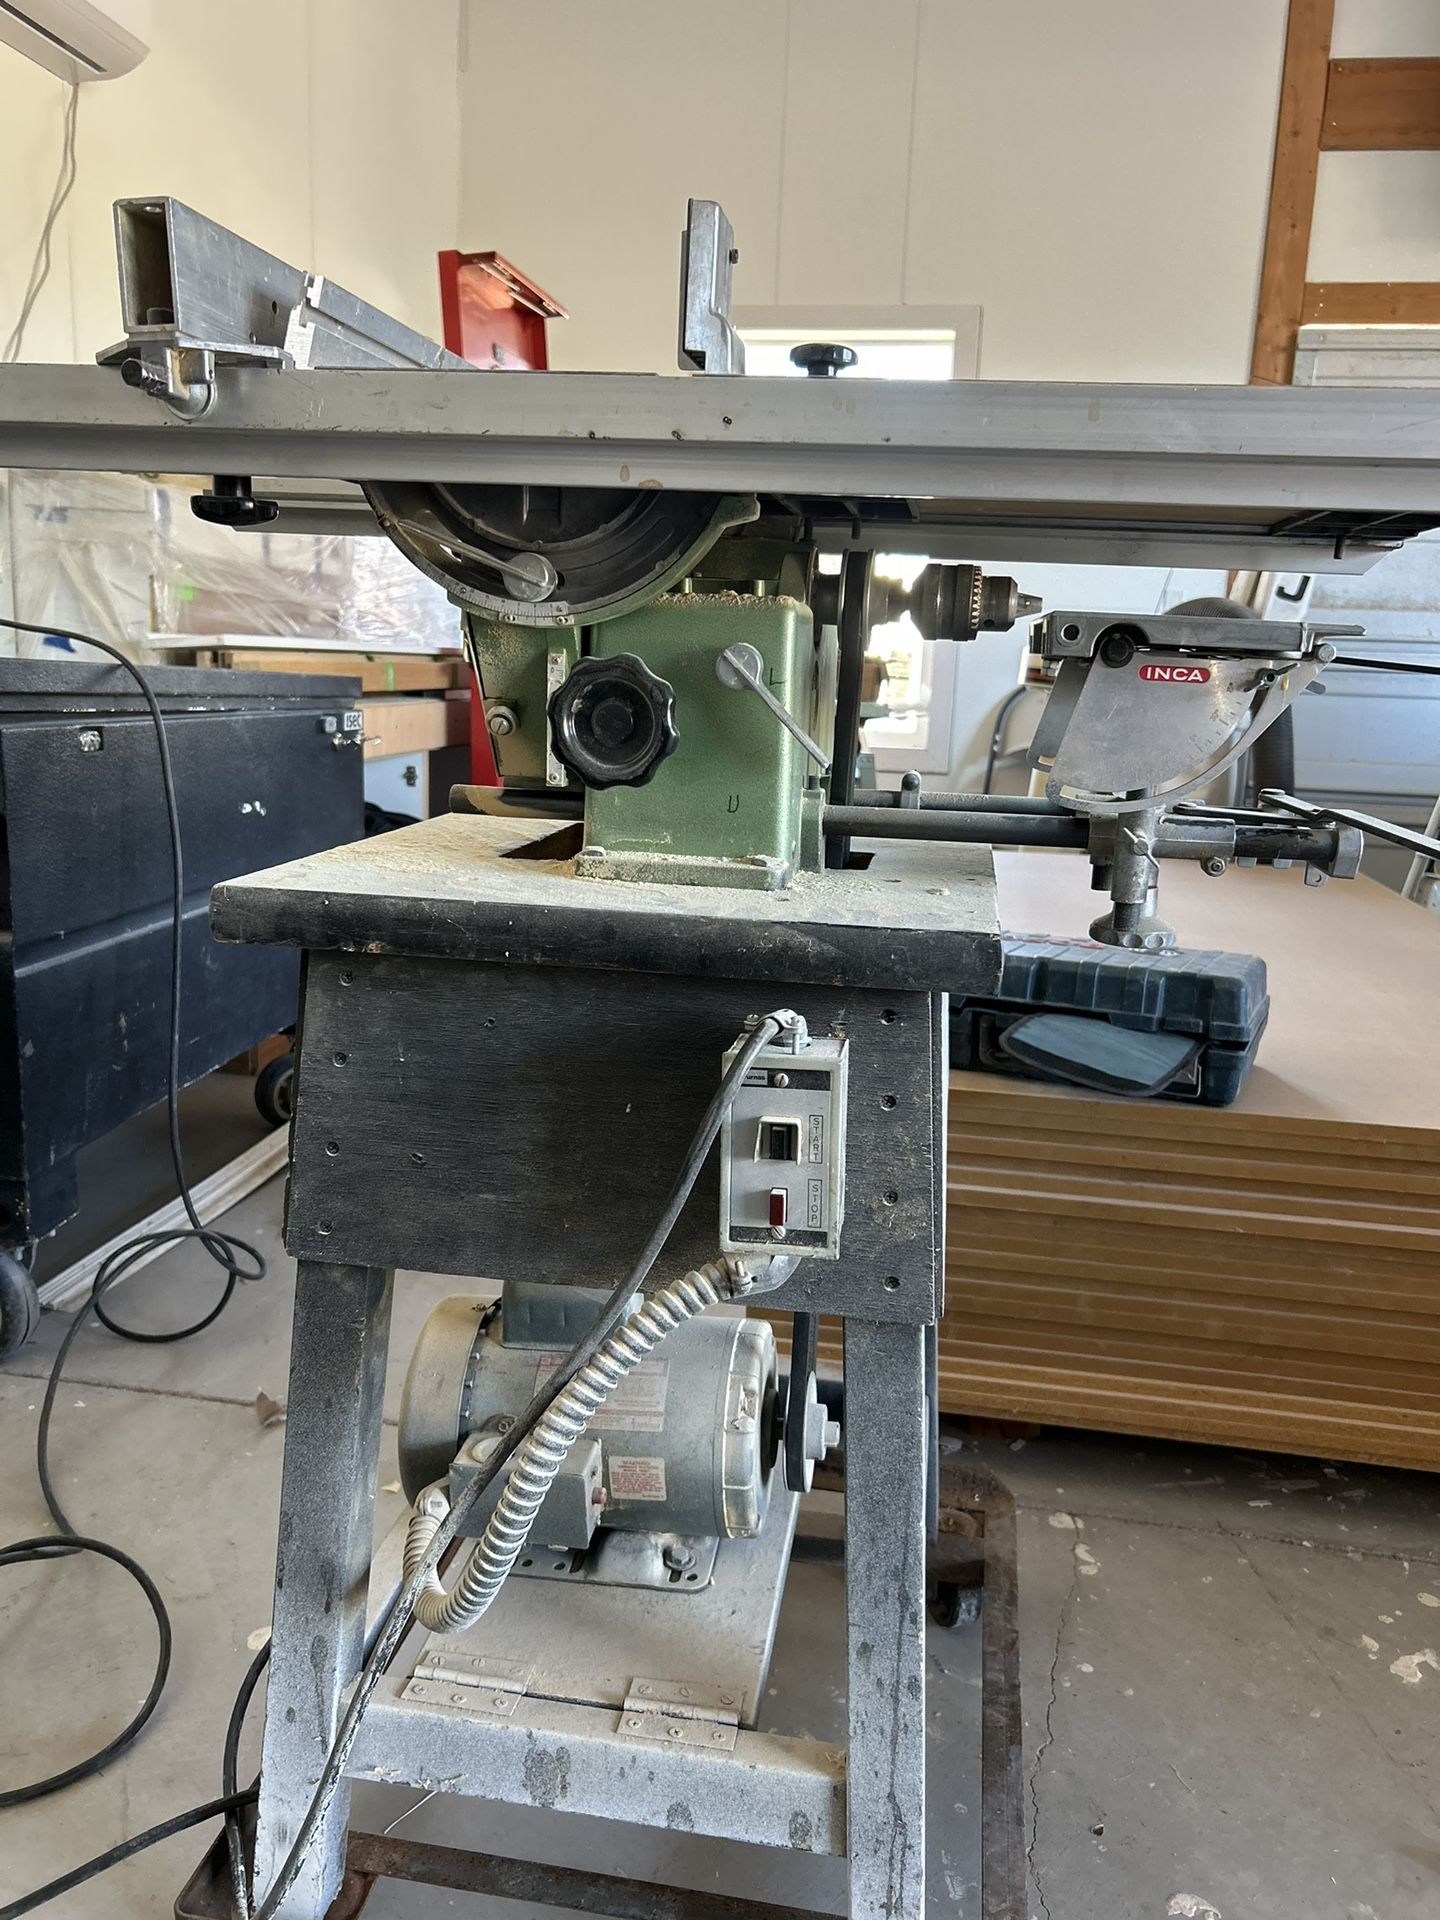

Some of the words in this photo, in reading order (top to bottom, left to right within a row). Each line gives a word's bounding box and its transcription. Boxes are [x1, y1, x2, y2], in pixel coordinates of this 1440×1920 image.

[1146, 666, 1204, 682] INCA
[812, 1117, 820, 1161] START
[810, 1184, 819, 1223] STOP
